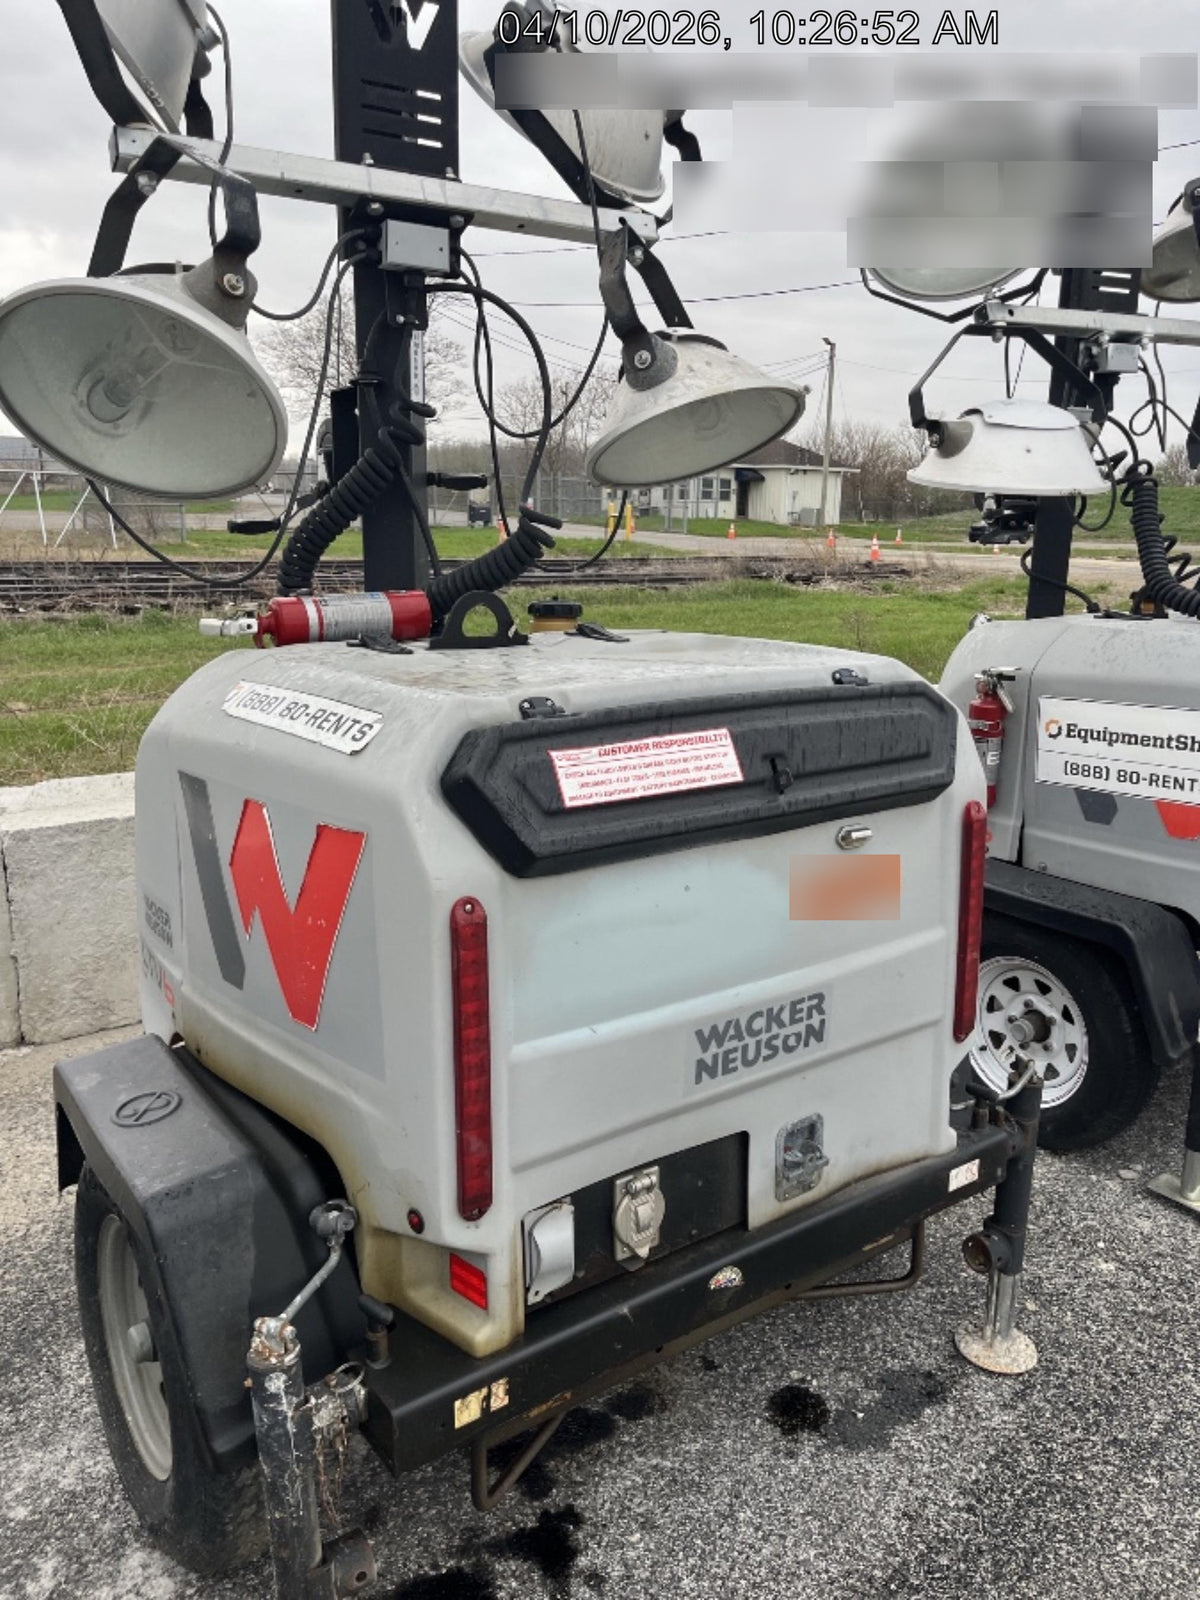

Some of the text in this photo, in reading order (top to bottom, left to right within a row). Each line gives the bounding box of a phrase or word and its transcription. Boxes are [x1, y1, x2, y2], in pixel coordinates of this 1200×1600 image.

[279, 701, 375, 742] 80-RENTS
[1064, 760, 1110, 781] (888)
[695, 992, 826, 1054] WACKER
[695, 1018, 826, 1085] NEUSON
